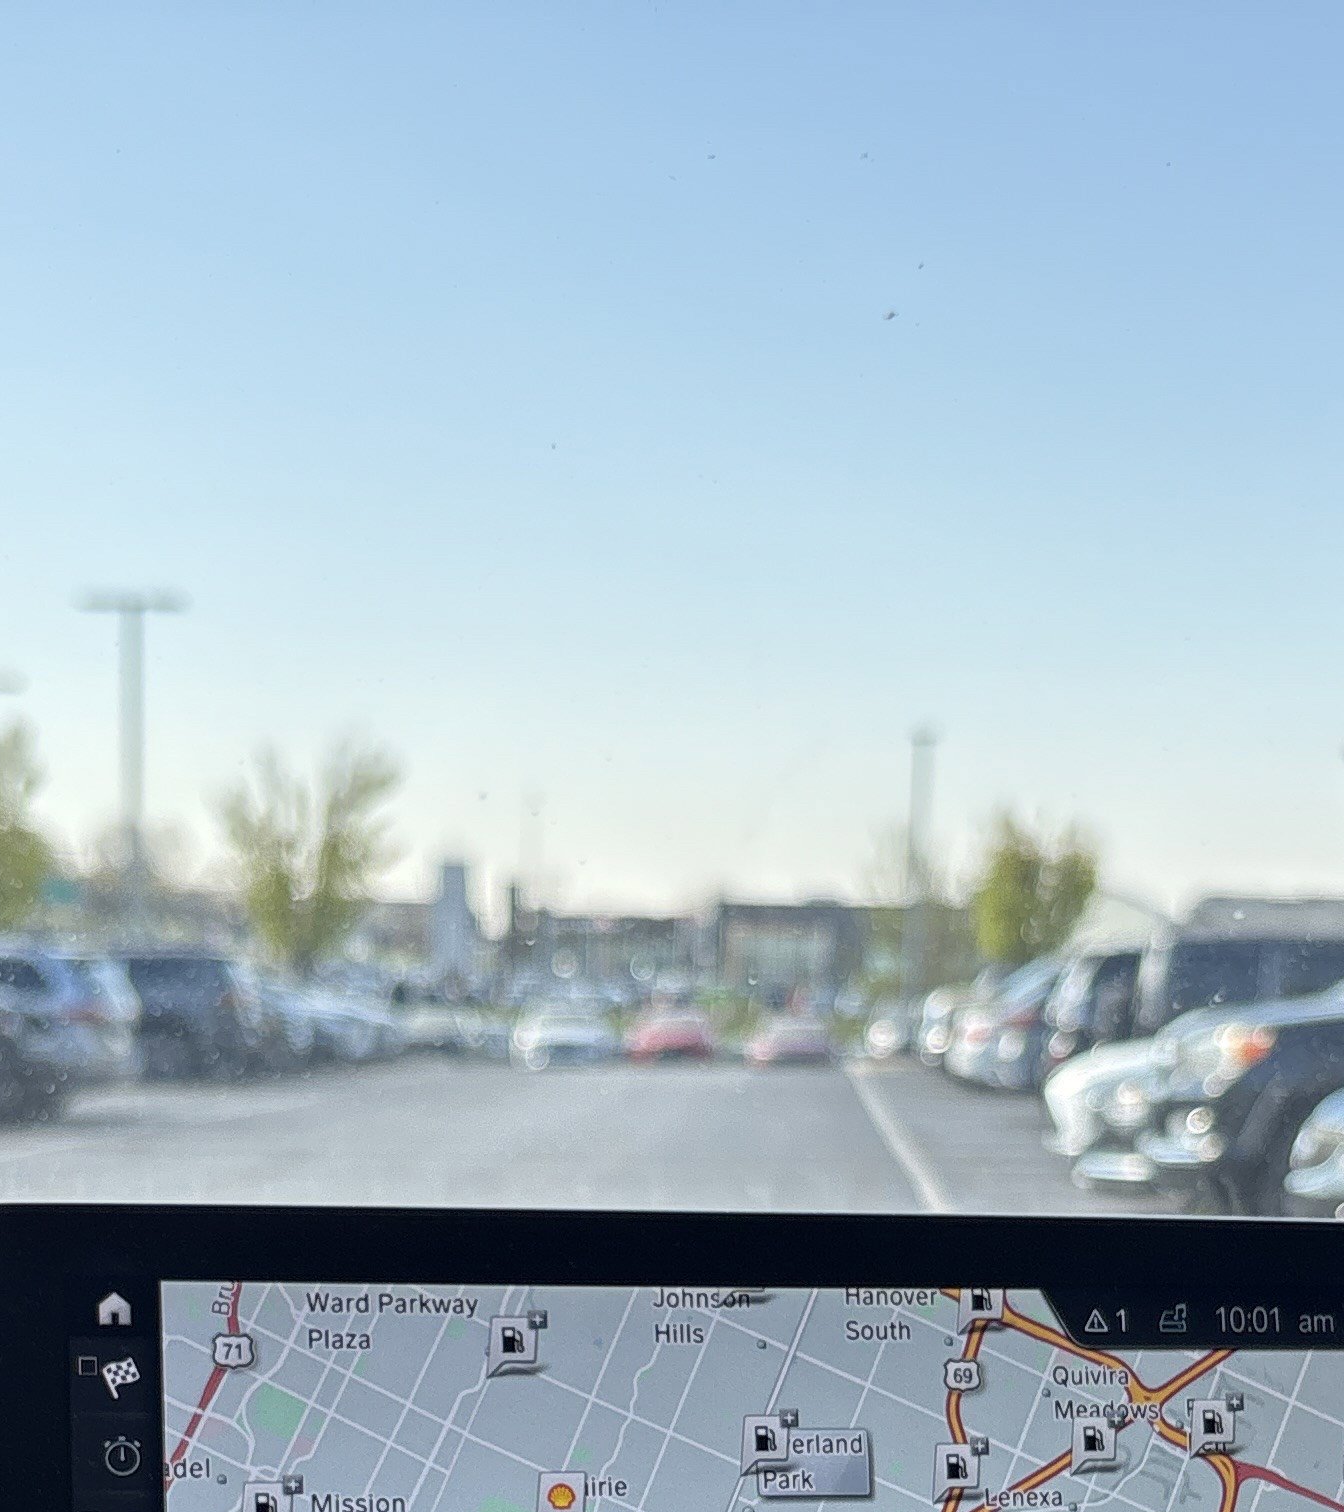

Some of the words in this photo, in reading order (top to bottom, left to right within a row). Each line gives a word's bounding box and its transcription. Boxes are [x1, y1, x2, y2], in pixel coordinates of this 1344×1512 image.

[307, 1293, 370, 1314] Ward
[378, 1293, 478, 1318] Parkway
[653, 1288, 751, 1309] Johnson
[845, 1288, 938, 1307] Hanover
[846, 1321, 912, 1341] South
[1115, 1310, 1127, 1332] 1
[1215, 1309, 1282, 1332] 10:01
[1298, 1314, 1336, 1332] am
[308, 1330, 371, 1350] Plaza
[655, 1323, 705, 1344] Hills
[223, 1342, 243, 1360] 71
[953, 1368, 973, 1385] 69
[1052, 1366, 1130, 1387] Quivira
[1055, 1400, 1160, 1420] Meadows
[792, 1433, 863, 1454] erland
[763, 1469, 814, 1490] Park
[985, 1487, 1063, 1507] Lenexa
